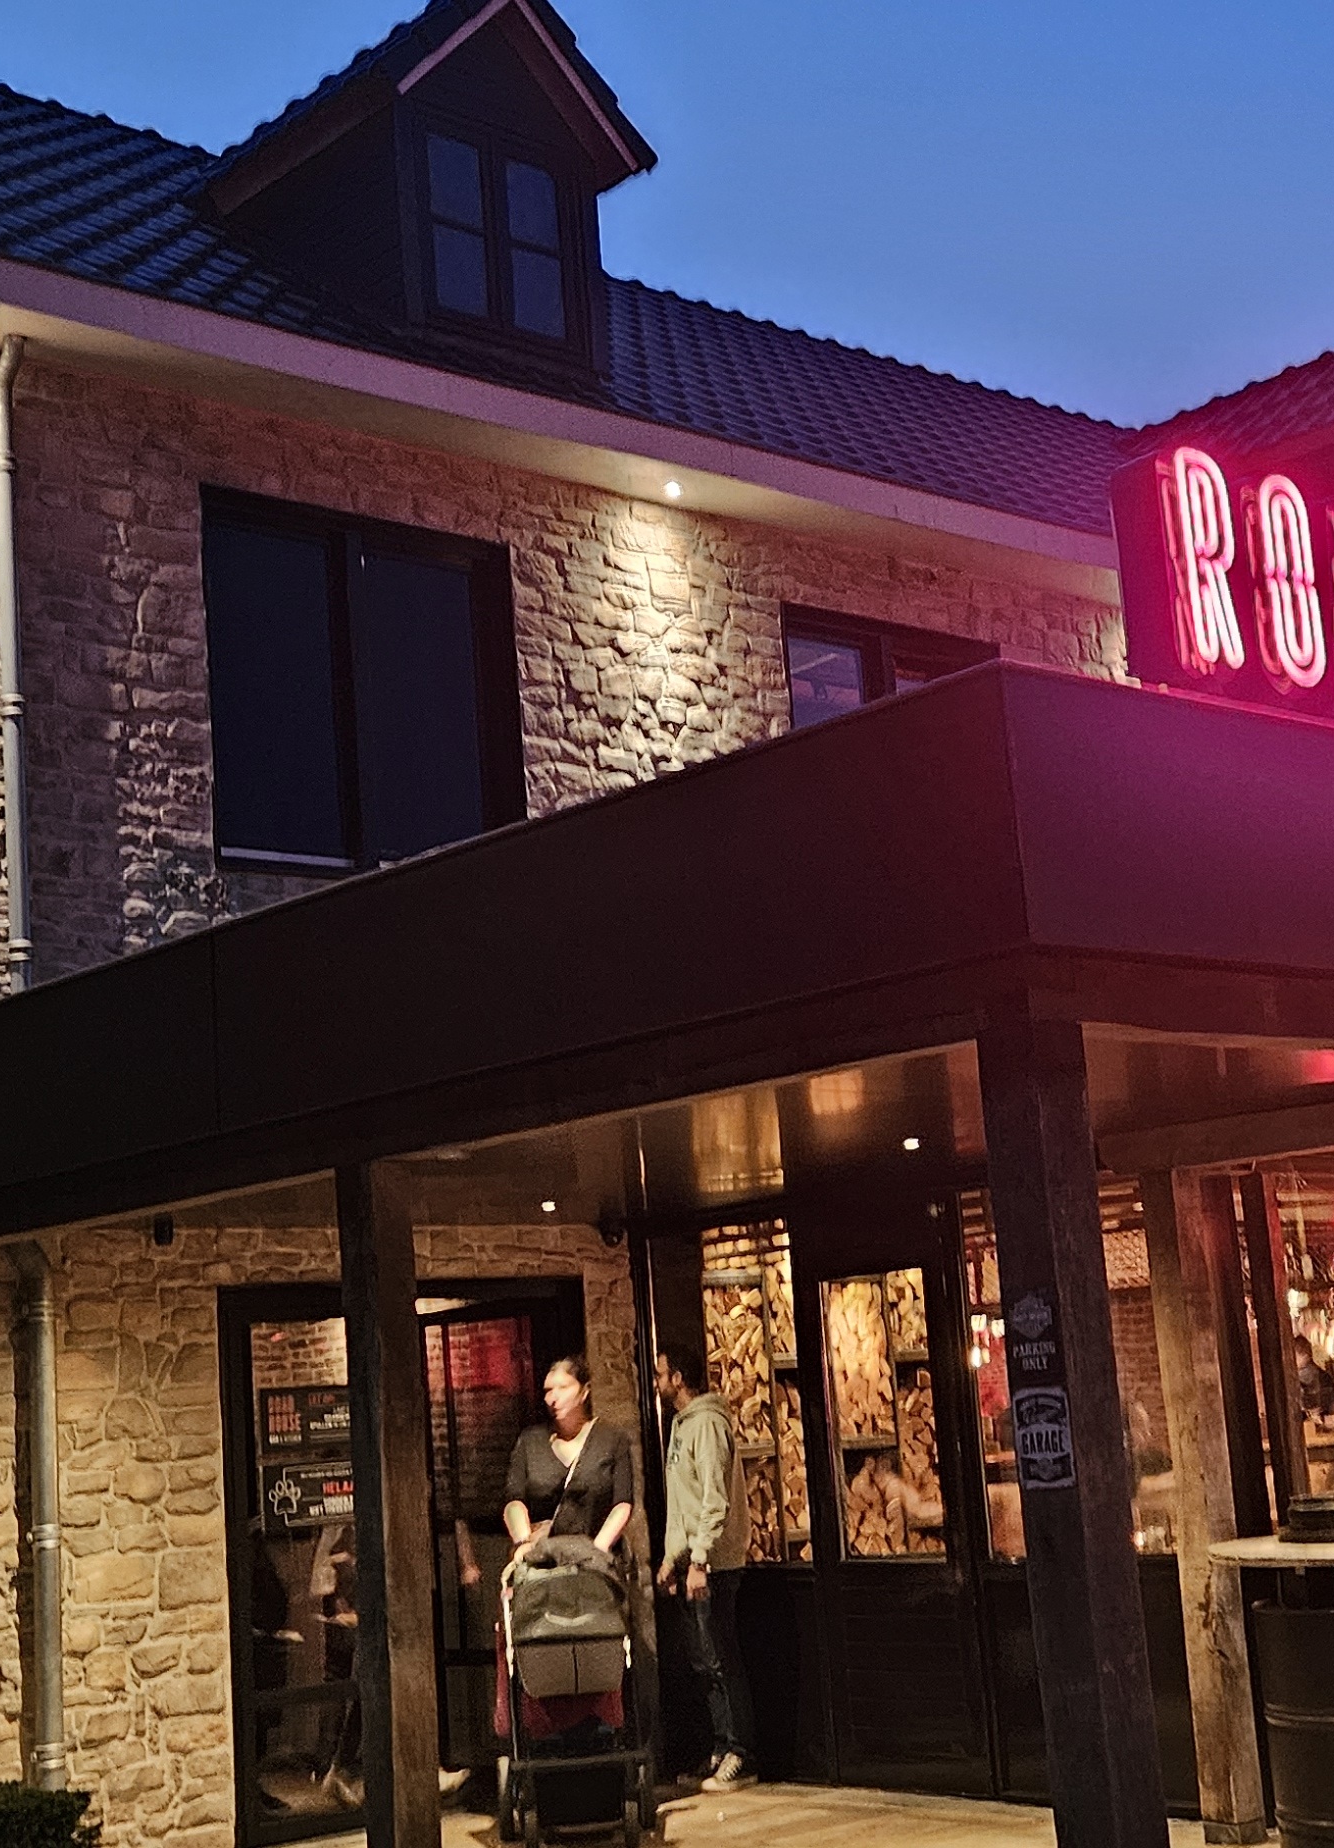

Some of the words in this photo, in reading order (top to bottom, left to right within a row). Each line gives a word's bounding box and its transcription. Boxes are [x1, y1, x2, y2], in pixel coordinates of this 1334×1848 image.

[1012, 1340, 1056, 1358] PARKING
[1022, 1356, 1049, 1371] ONLY
[1021, 1429, 1066, 1455] GARAGE
